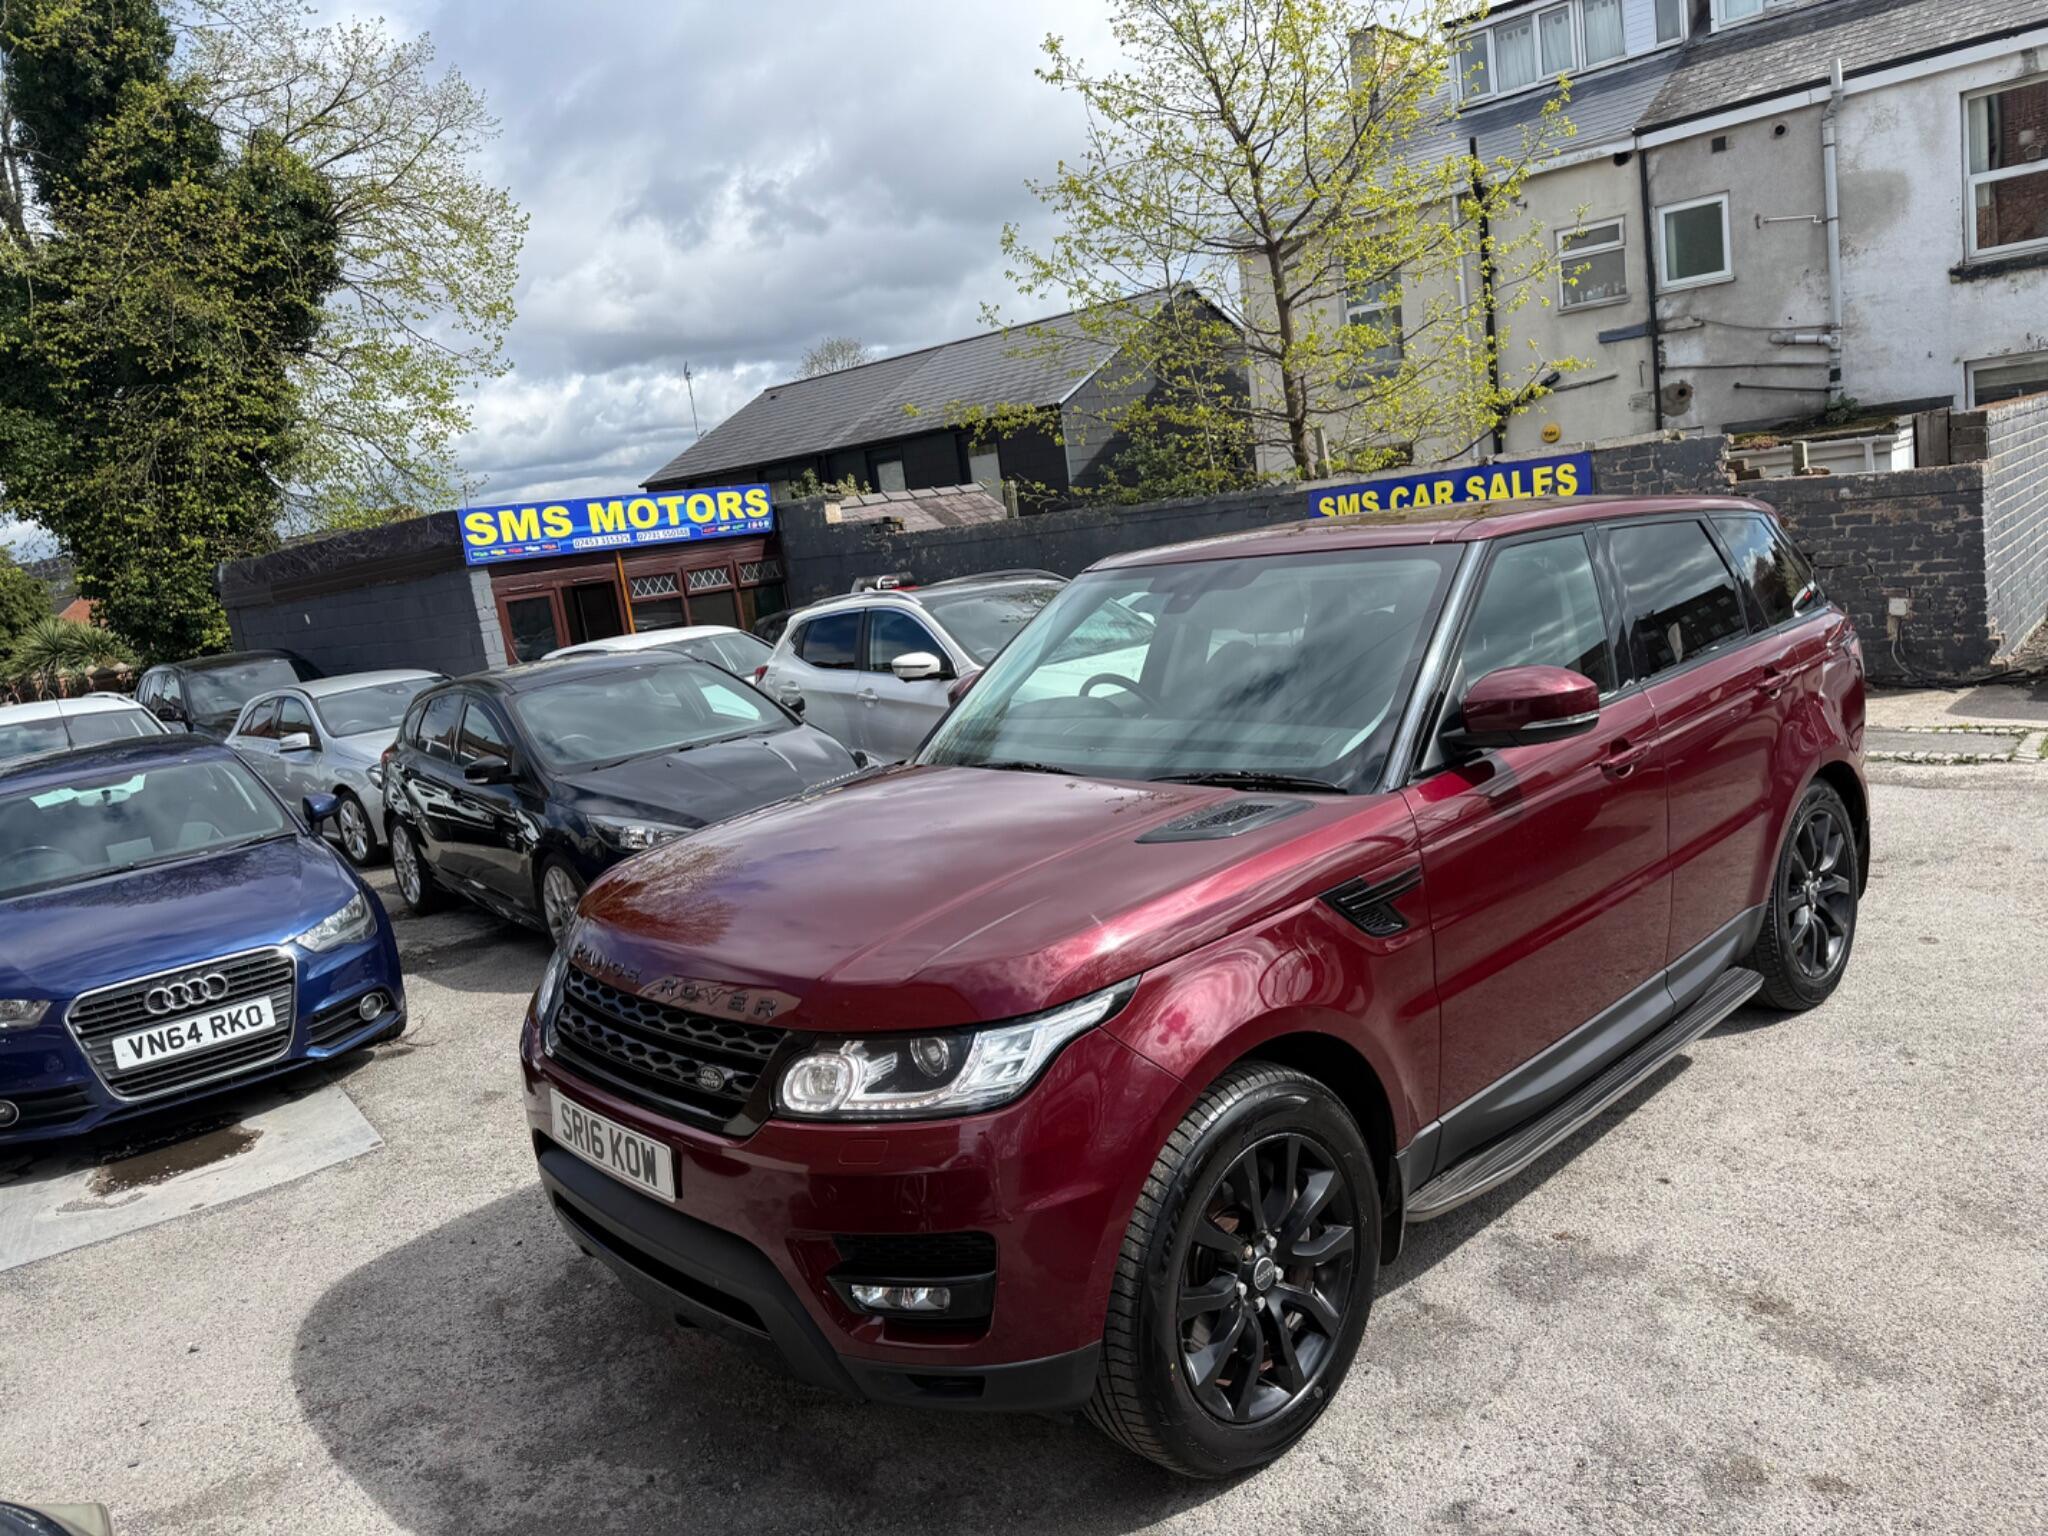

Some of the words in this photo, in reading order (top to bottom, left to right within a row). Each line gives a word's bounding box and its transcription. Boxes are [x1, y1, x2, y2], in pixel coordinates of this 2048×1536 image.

[464, 506, 573, 545] SMS
[587, 488, 770, 534] MOTORS
[1319, 491, 1380, 516] SMS
[1389, 480, 1455, 509] CAR
[1466, 463, 1578, 502] SALES
[658, 976, 778, 1018] ROVER
[128, 1022, 203, 1060] VN64
[209, 1005, 264, 1038] RKO
[561, 1103, 605, 1161] SR16
[609, 1128, 658, 1188] KOW
